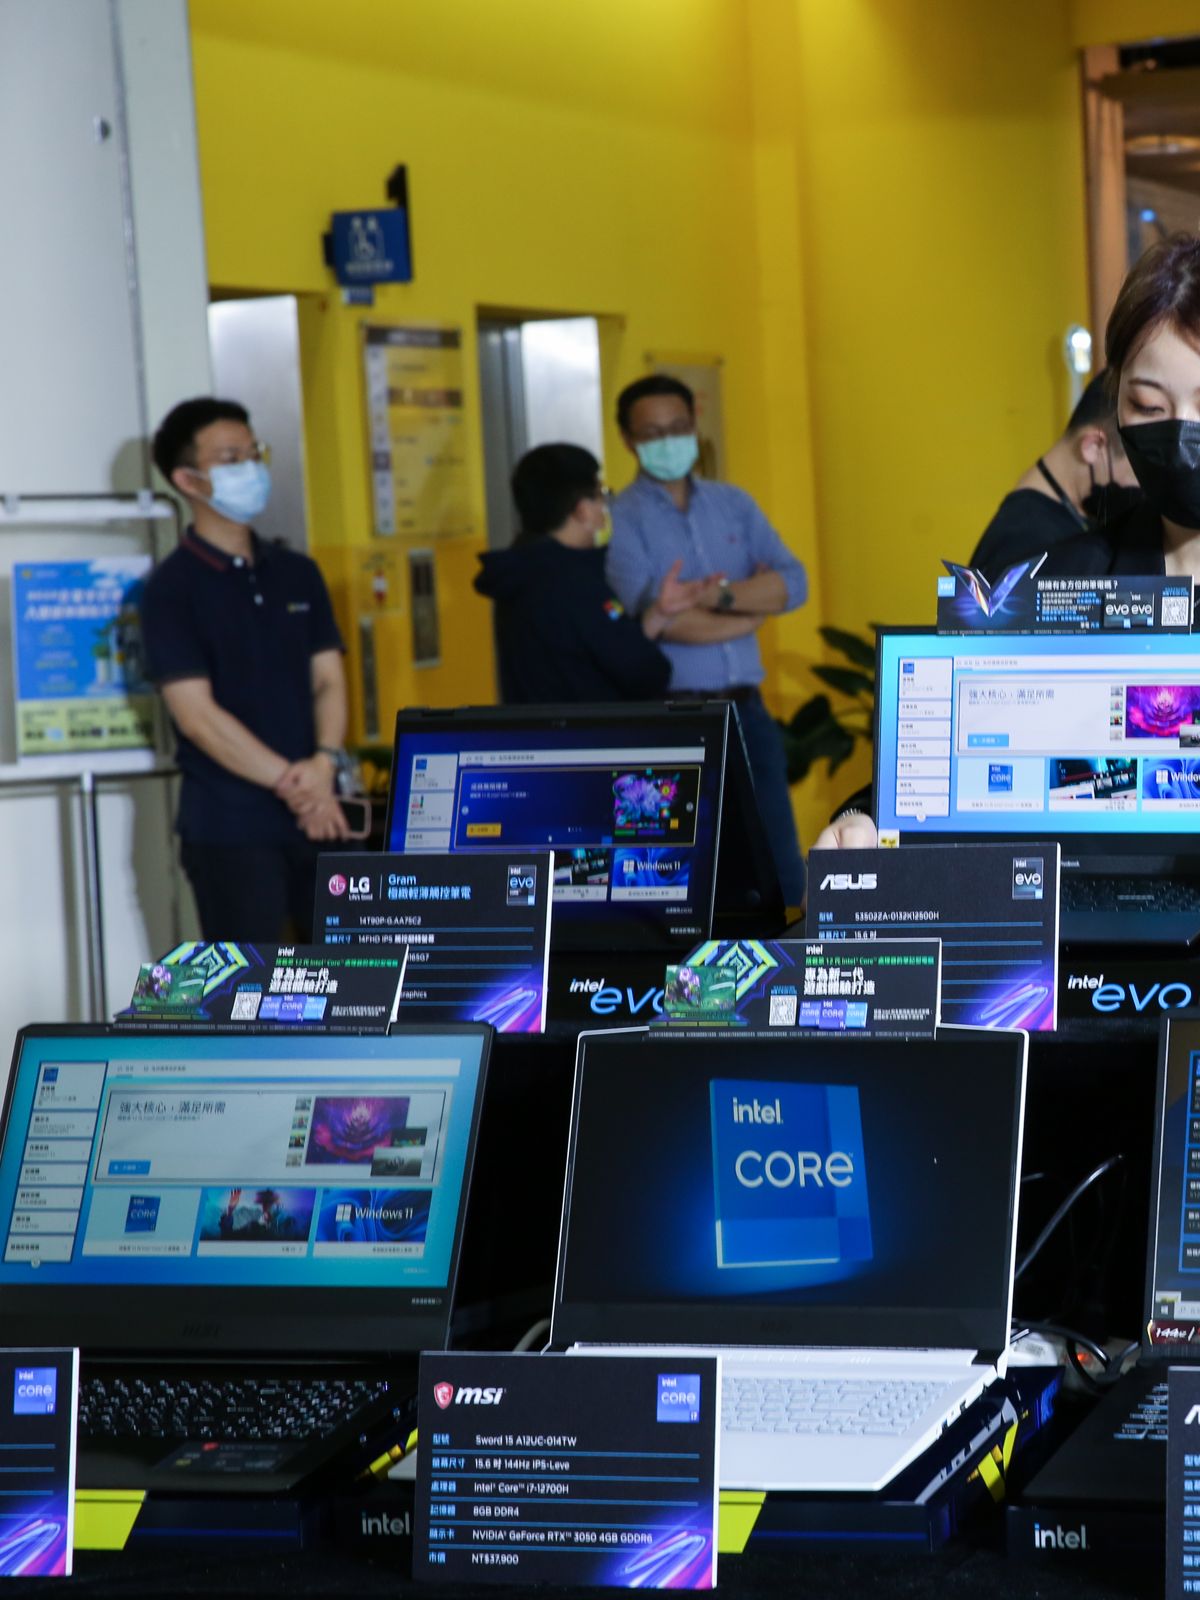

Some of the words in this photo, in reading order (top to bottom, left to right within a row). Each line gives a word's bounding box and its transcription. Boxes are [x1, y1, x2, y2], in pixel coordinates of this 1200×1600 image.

[1105, 605, 1129, 615] evo
[1131, 605, 1152, 615] evo
[636, 860, 672, 871] Windows
[349, 876, 371, 893] LG
[388, 874, 417, 885] Gram
[510, 877, 534, 888] evo
[819, 873, 878, 890] ASUS
[1015, 873, 1041, 886] evo
[569, 977, 605, 993] intel
[1068, 974, 1105, 990] intel
[1091, 982, 1192, 1012] evo
[732, 1096, 784, 1124] intel
[354, 1206, 403, 1220] Windows
[404, 1207, 414, 1219] 11
[455, 1386, 504, 1405] msi
[475, 1434, 502, 1446] Sword
[505, 1435, 514, 1446] 15
[475, 1458, 491, 1470] 15.6
[504, 1458, 530, 1470] 144Hz
[526, 1482, 569, 1495] i7-12700H
[473, 1505, 491, 1517] 8GB
[494, 1505, 520, 1517] DDR4
[361, 1512, 412, 1536] intel
[509, 1530, 545, 1542] GeForce
[574, 1531, 597, 1543] 3050
[599, 1532, 618, 1544] 4GB
[1034, 1523, 1088, 1549] intel
